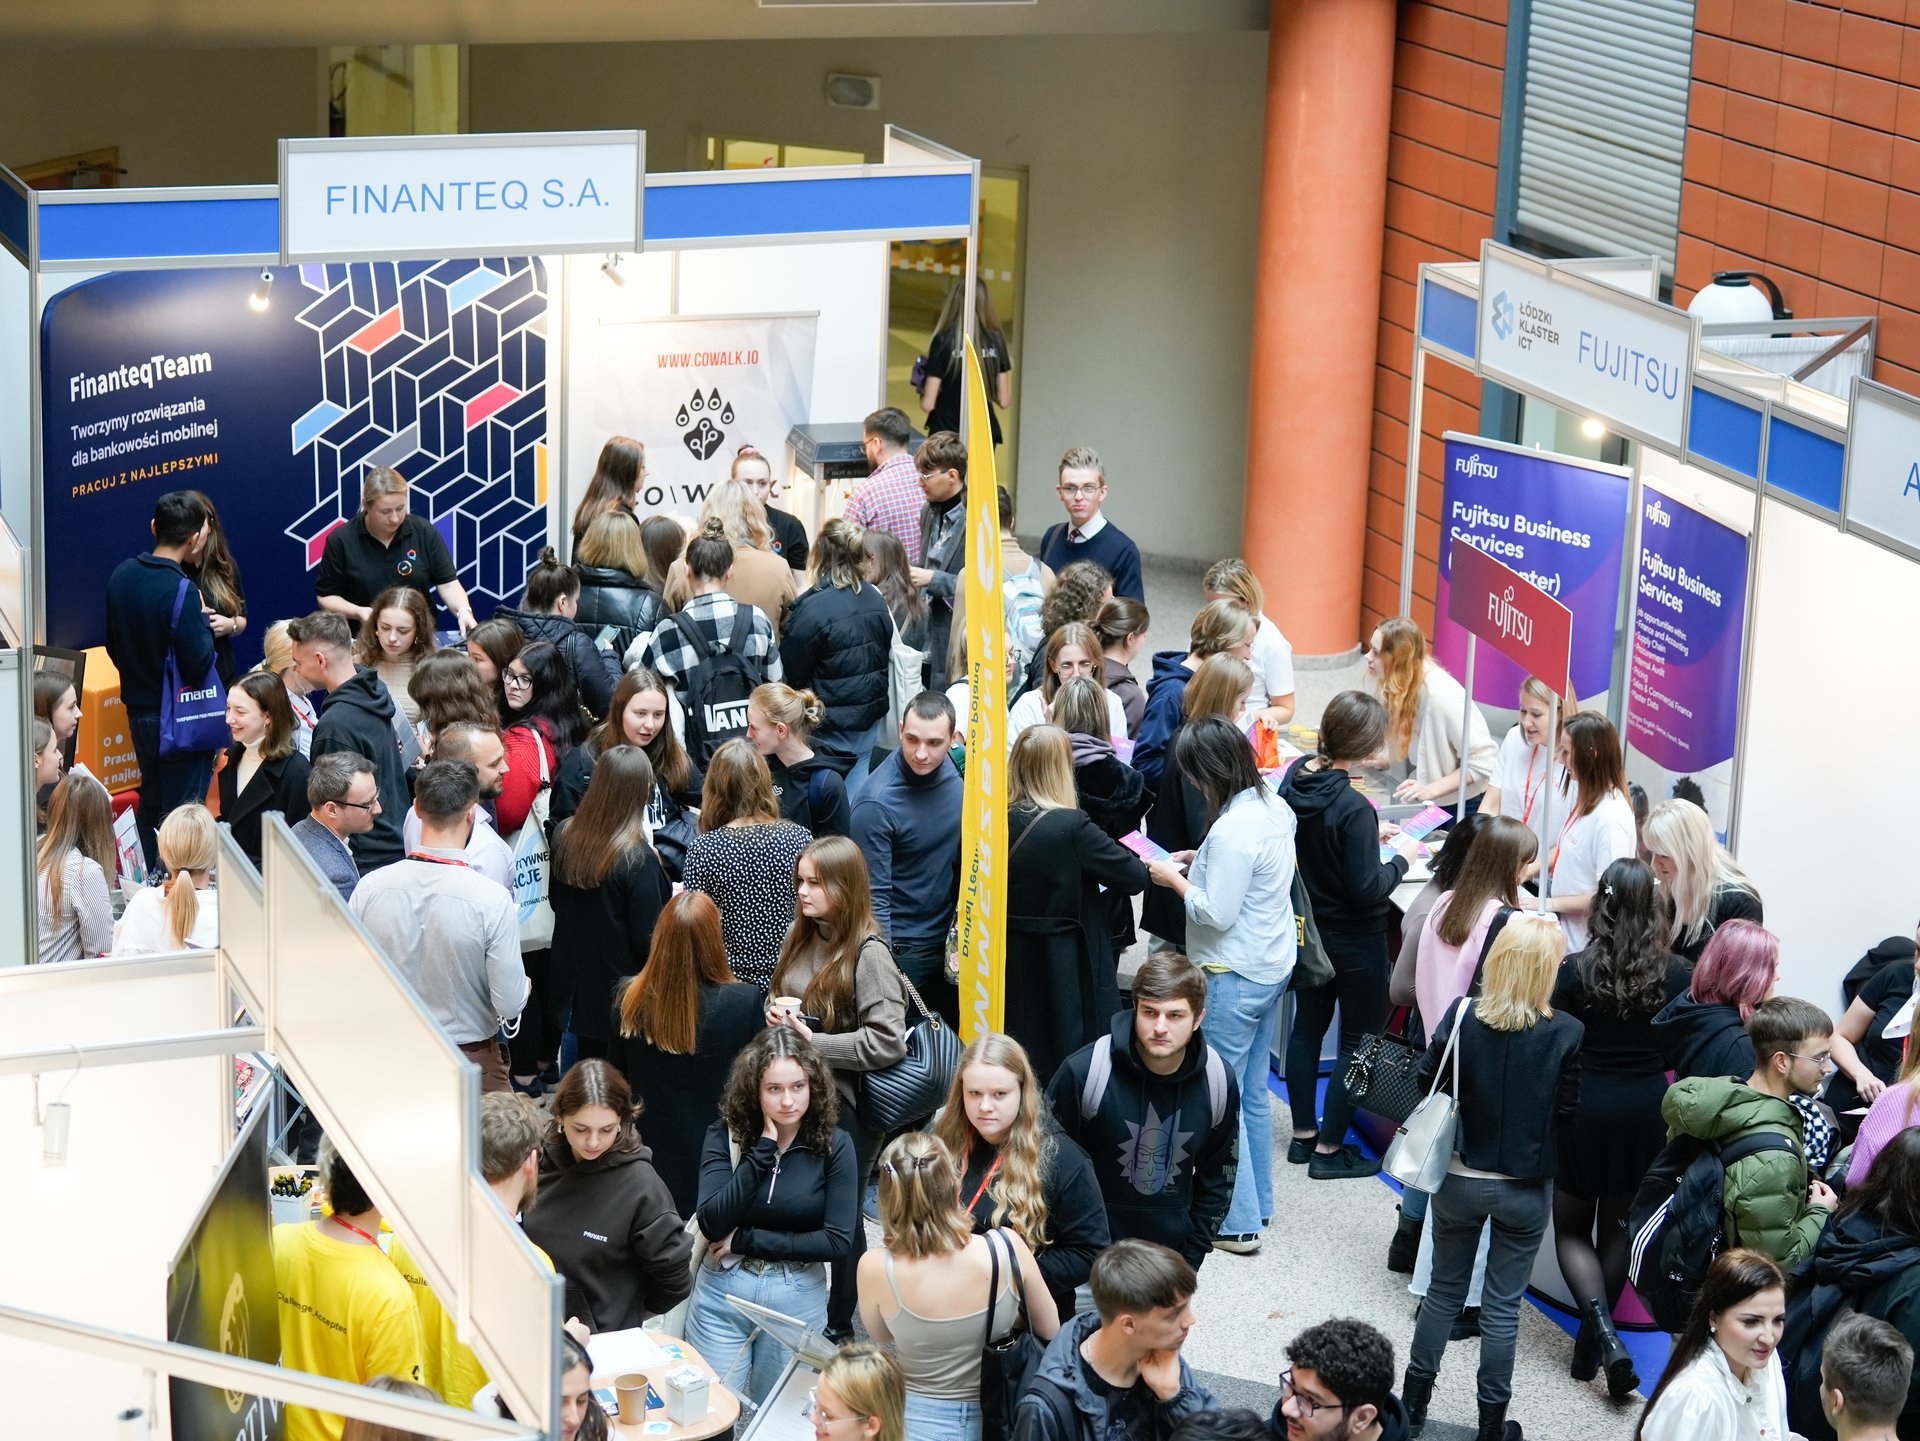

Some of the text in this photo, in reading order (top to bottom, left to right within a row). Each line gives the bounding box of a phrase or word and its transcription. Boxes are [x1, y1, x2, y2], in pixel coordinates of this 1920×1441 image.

[326, 178, 610, 215] FINANTEQ S.A.
[1519, 301, 1552, 325] ŁÓDZKI
[1519, 318, 1560, 345] KLASTER
[657, 350, 760, 369] WWW.COWALK.IO
[1518, 335, 1533, 351] ICT
[70, 352, 212, 402] FinanteqTeam
[1578, 330, 1679, 400] FUJITSU
[71, 397, 206, 440] Tworzymy rozwiązania
[71, 419, 219, 467] dla bankowości mobilnej
[72, 453, 219, 498] PRACUJ Z NAJLEPSZYMI
[1455, 454, 1498, 479] FUJITSU
[1452, 501, 1591, 549] Fujitsu Business
[1639, 574, 1683, 613] Services
[1641, 548, 1721, 607] Fujitsu Business
[1487, 585, 1533, 646] FUJITSU
[181, 685, 217, 703] marel
[704, 699, 749, 732] VAN
[583, 1230, 608, 1242] PRIVATE
